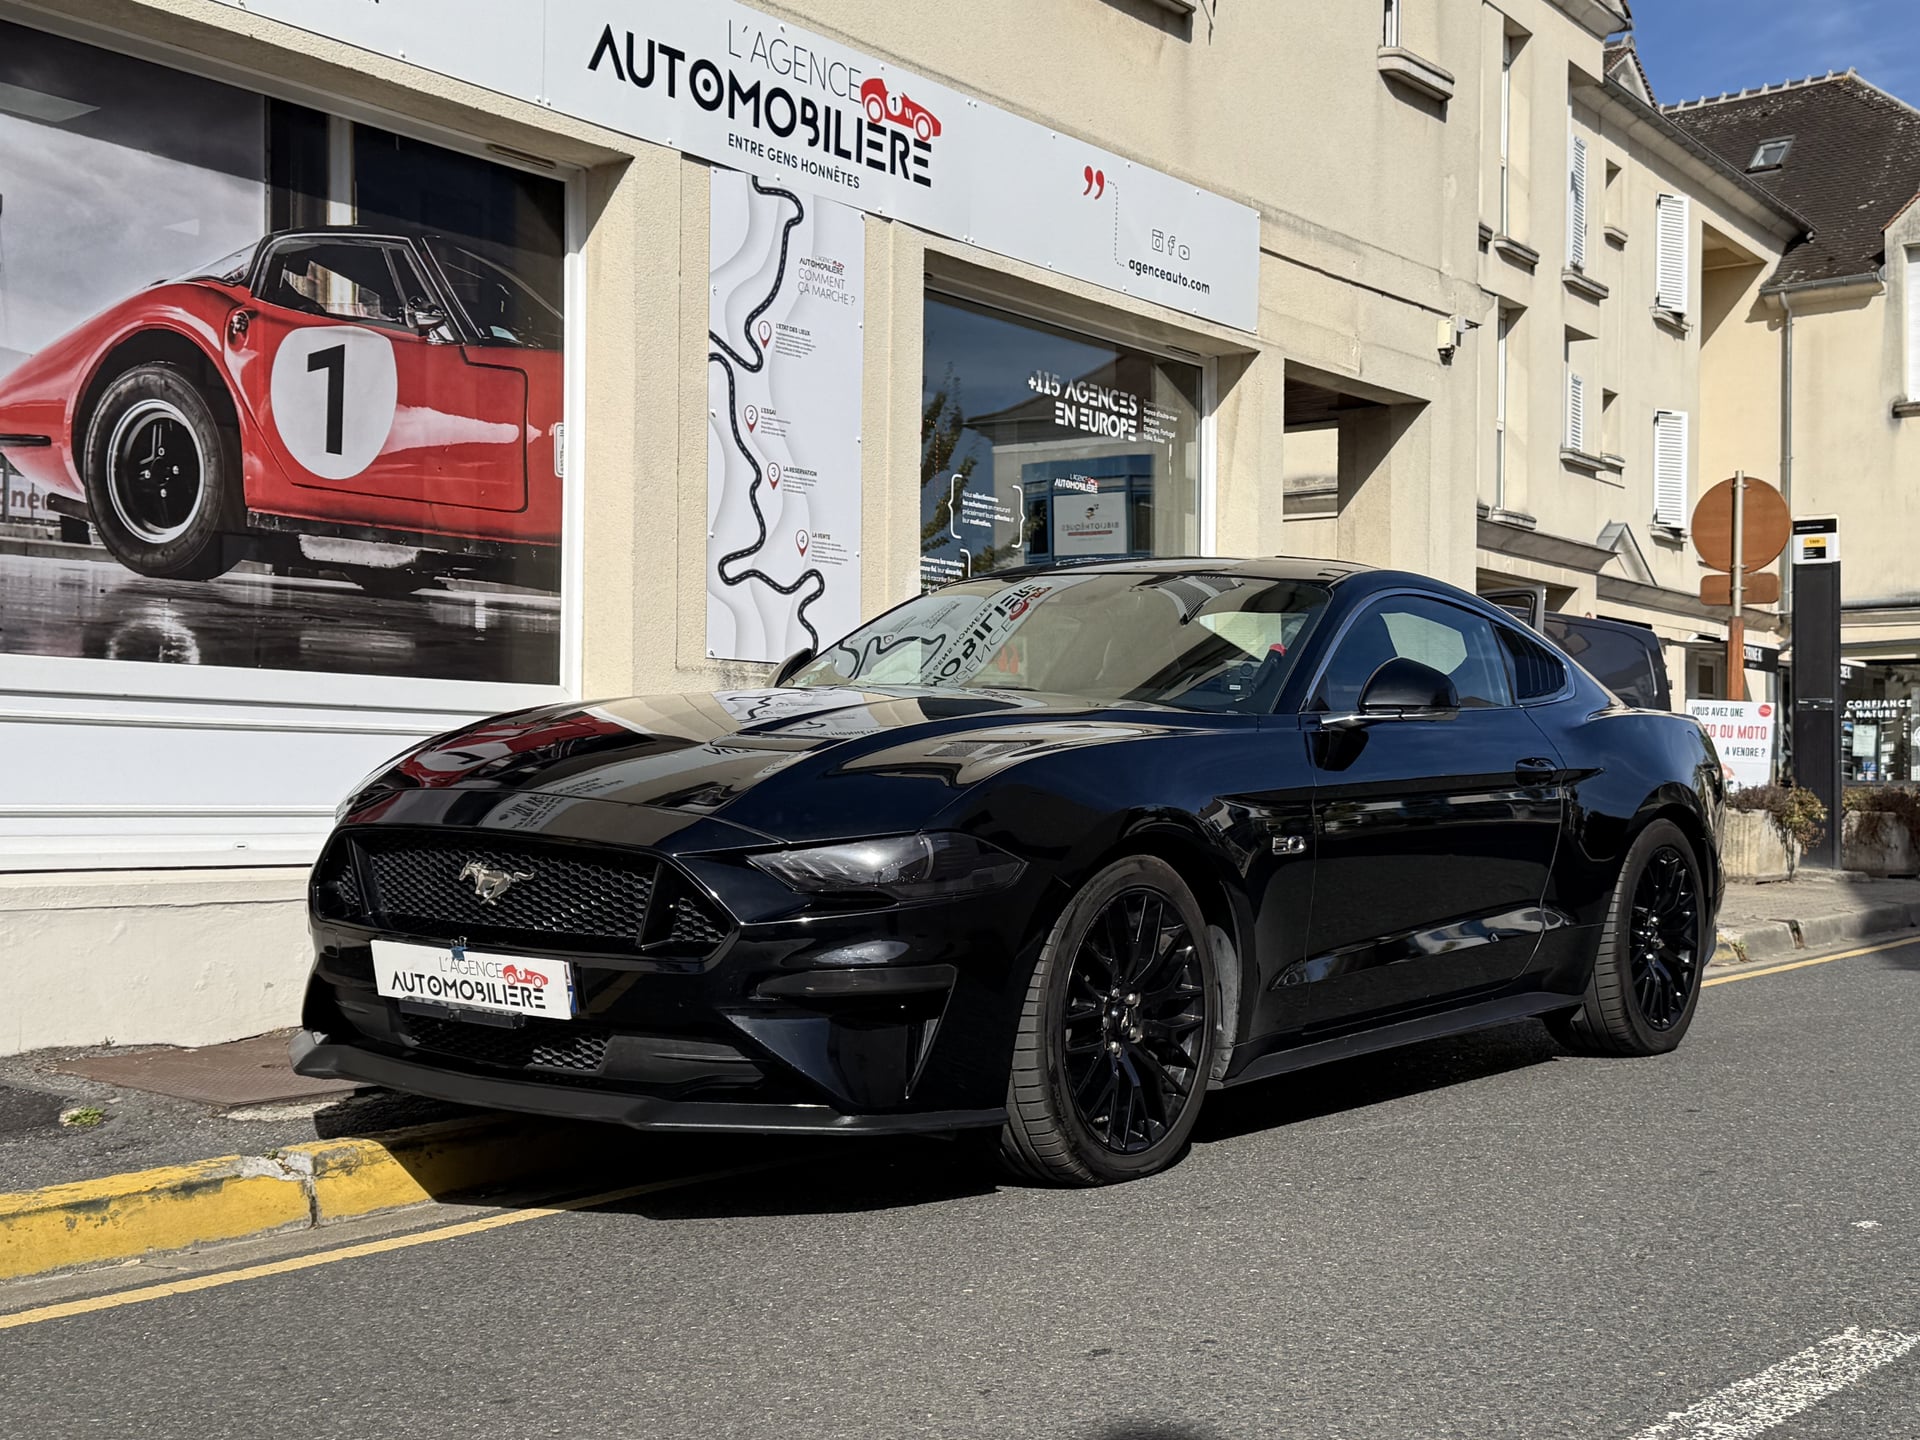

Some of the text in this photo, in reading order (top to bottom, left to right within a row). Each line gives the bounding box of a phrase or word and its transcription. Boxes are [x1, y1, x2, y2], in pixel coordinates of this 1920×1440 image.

[728, 19, 863, 104] L'AGENCE
[728, 133, 861, 190] ENTRE GENS HONNÊTES
[798, 267, 846, 290] COMMENT
[1128, 259, 1211, 295] agenceauto.com
[797, 281, 810, 296] ÇA
[812, 284, 849, 305] MARCHE
[305, 343, 347, 456] 1
[1028, 369, 1061, 397] +115
[1064, 378, 1138, 416] AGENCES
[748, 409, 754, 420] 2
[1055, 401, 1137, 442] EN EUROPE
[771, 467, 777, 477] 3
[800, 535, 805, 543] 4
[1692, 705, 1744, 717] VOUS AVEZ UNE
[1840, 710, 1897, 718] A NATURE
[1846, 699, 1912, 708] CONFIANCE
[1720, 724, 1733, 739] OU
[1737, 725, 1767, 740] MOTO
[1725, 746, 1766, 757] A VENDRE ?
[438, 956, 504, 979] L'AGENCE
